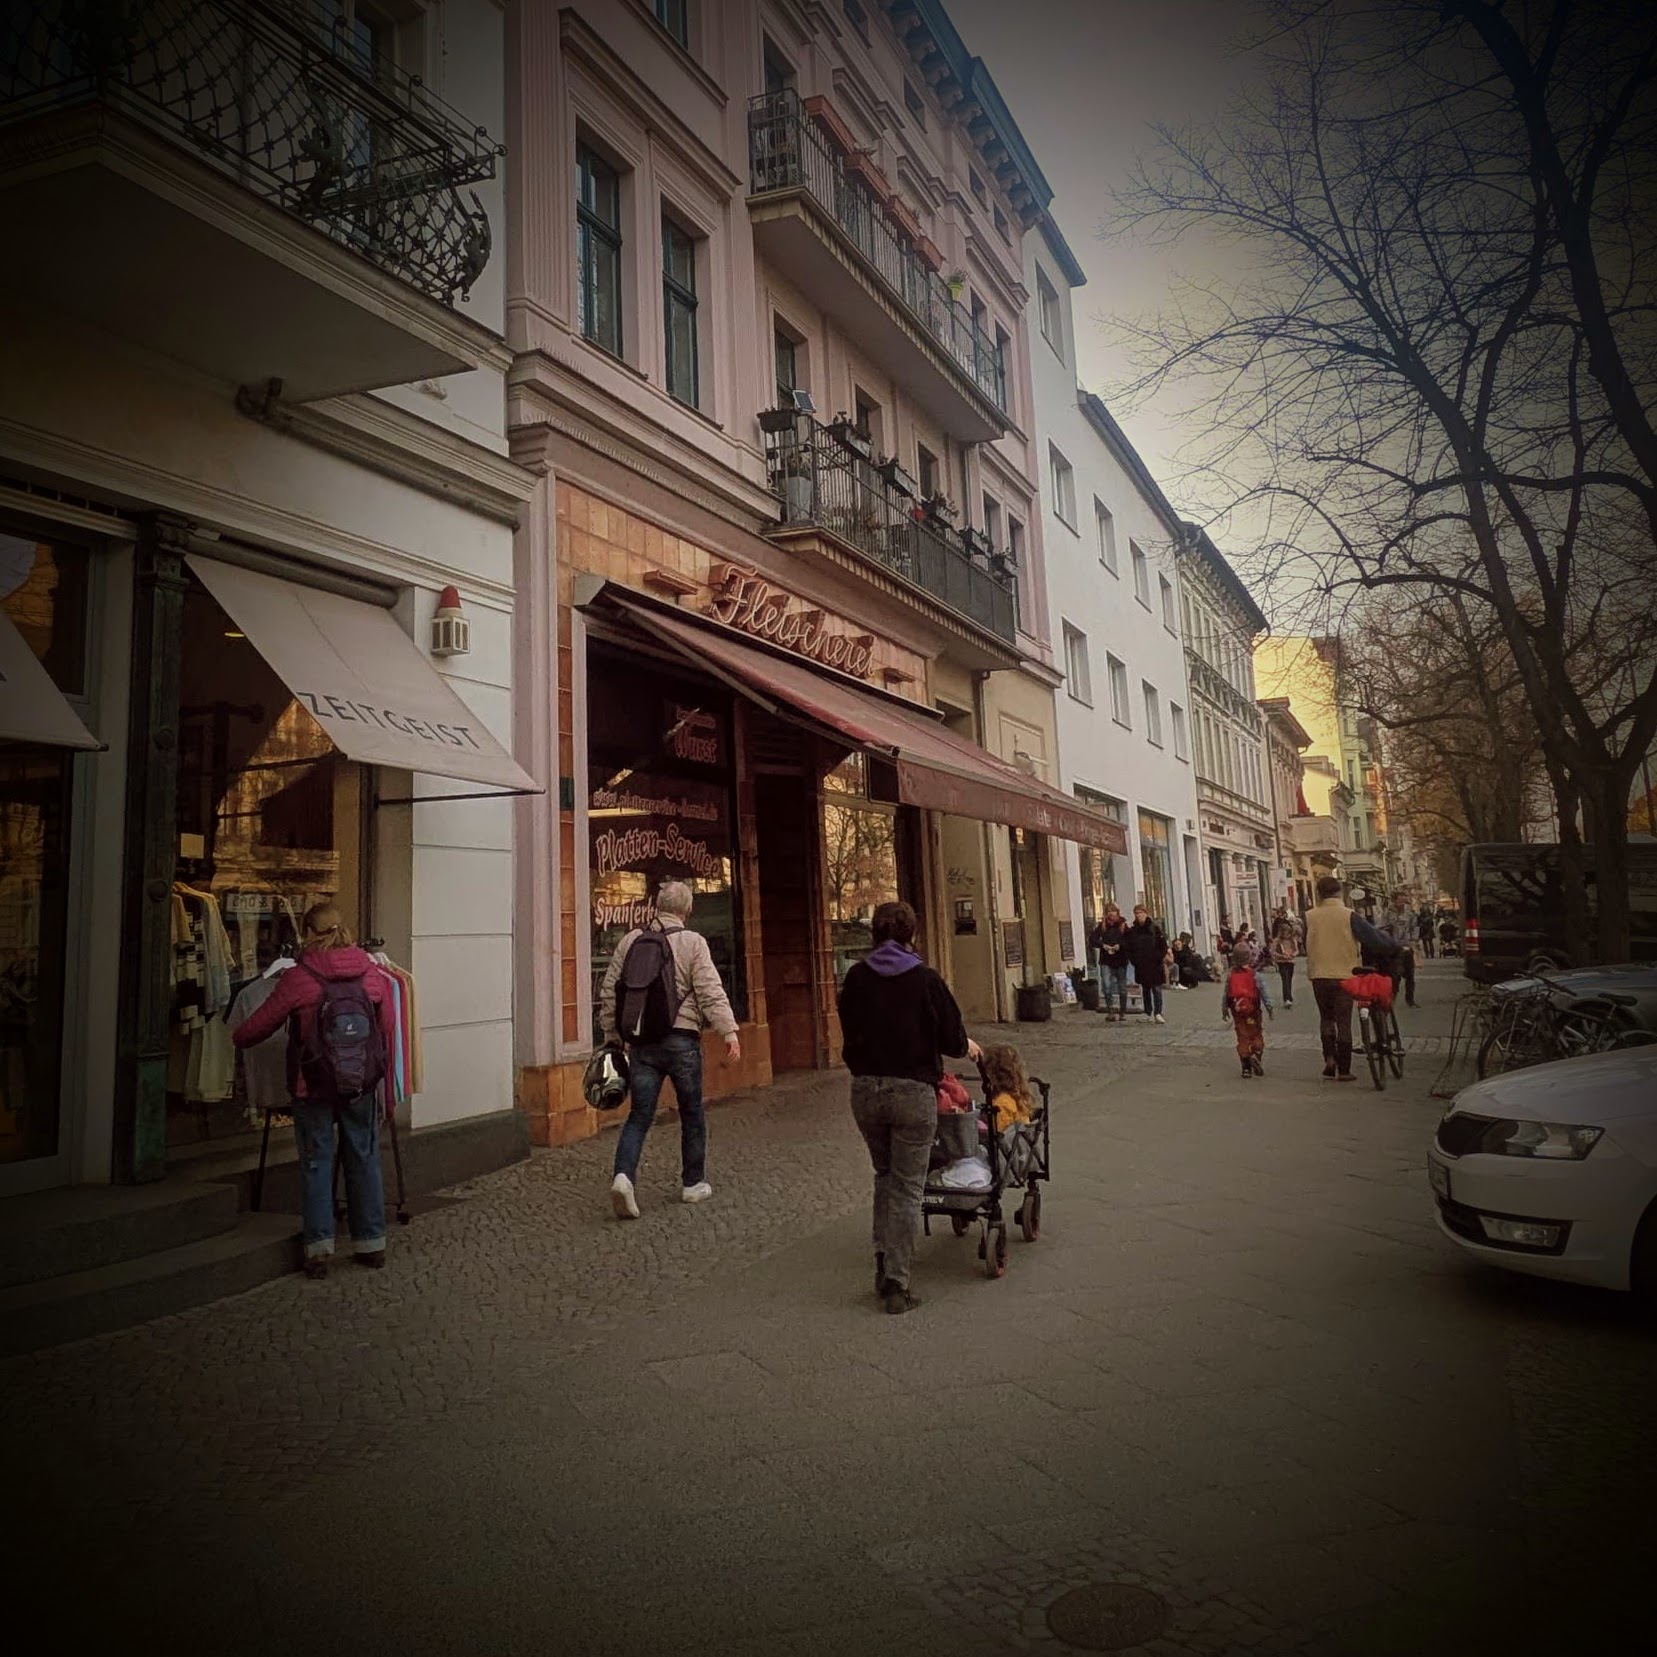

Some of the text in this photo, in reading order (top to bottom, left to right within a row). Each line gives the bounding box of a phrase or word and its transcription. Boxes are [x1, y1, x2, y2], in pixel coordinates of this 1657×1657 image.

[708, 563, 878, 678] Fleischerei
[296, 691, 481, 749] ZEITGEIST
[595, 897, 657, 931] Spanferk
